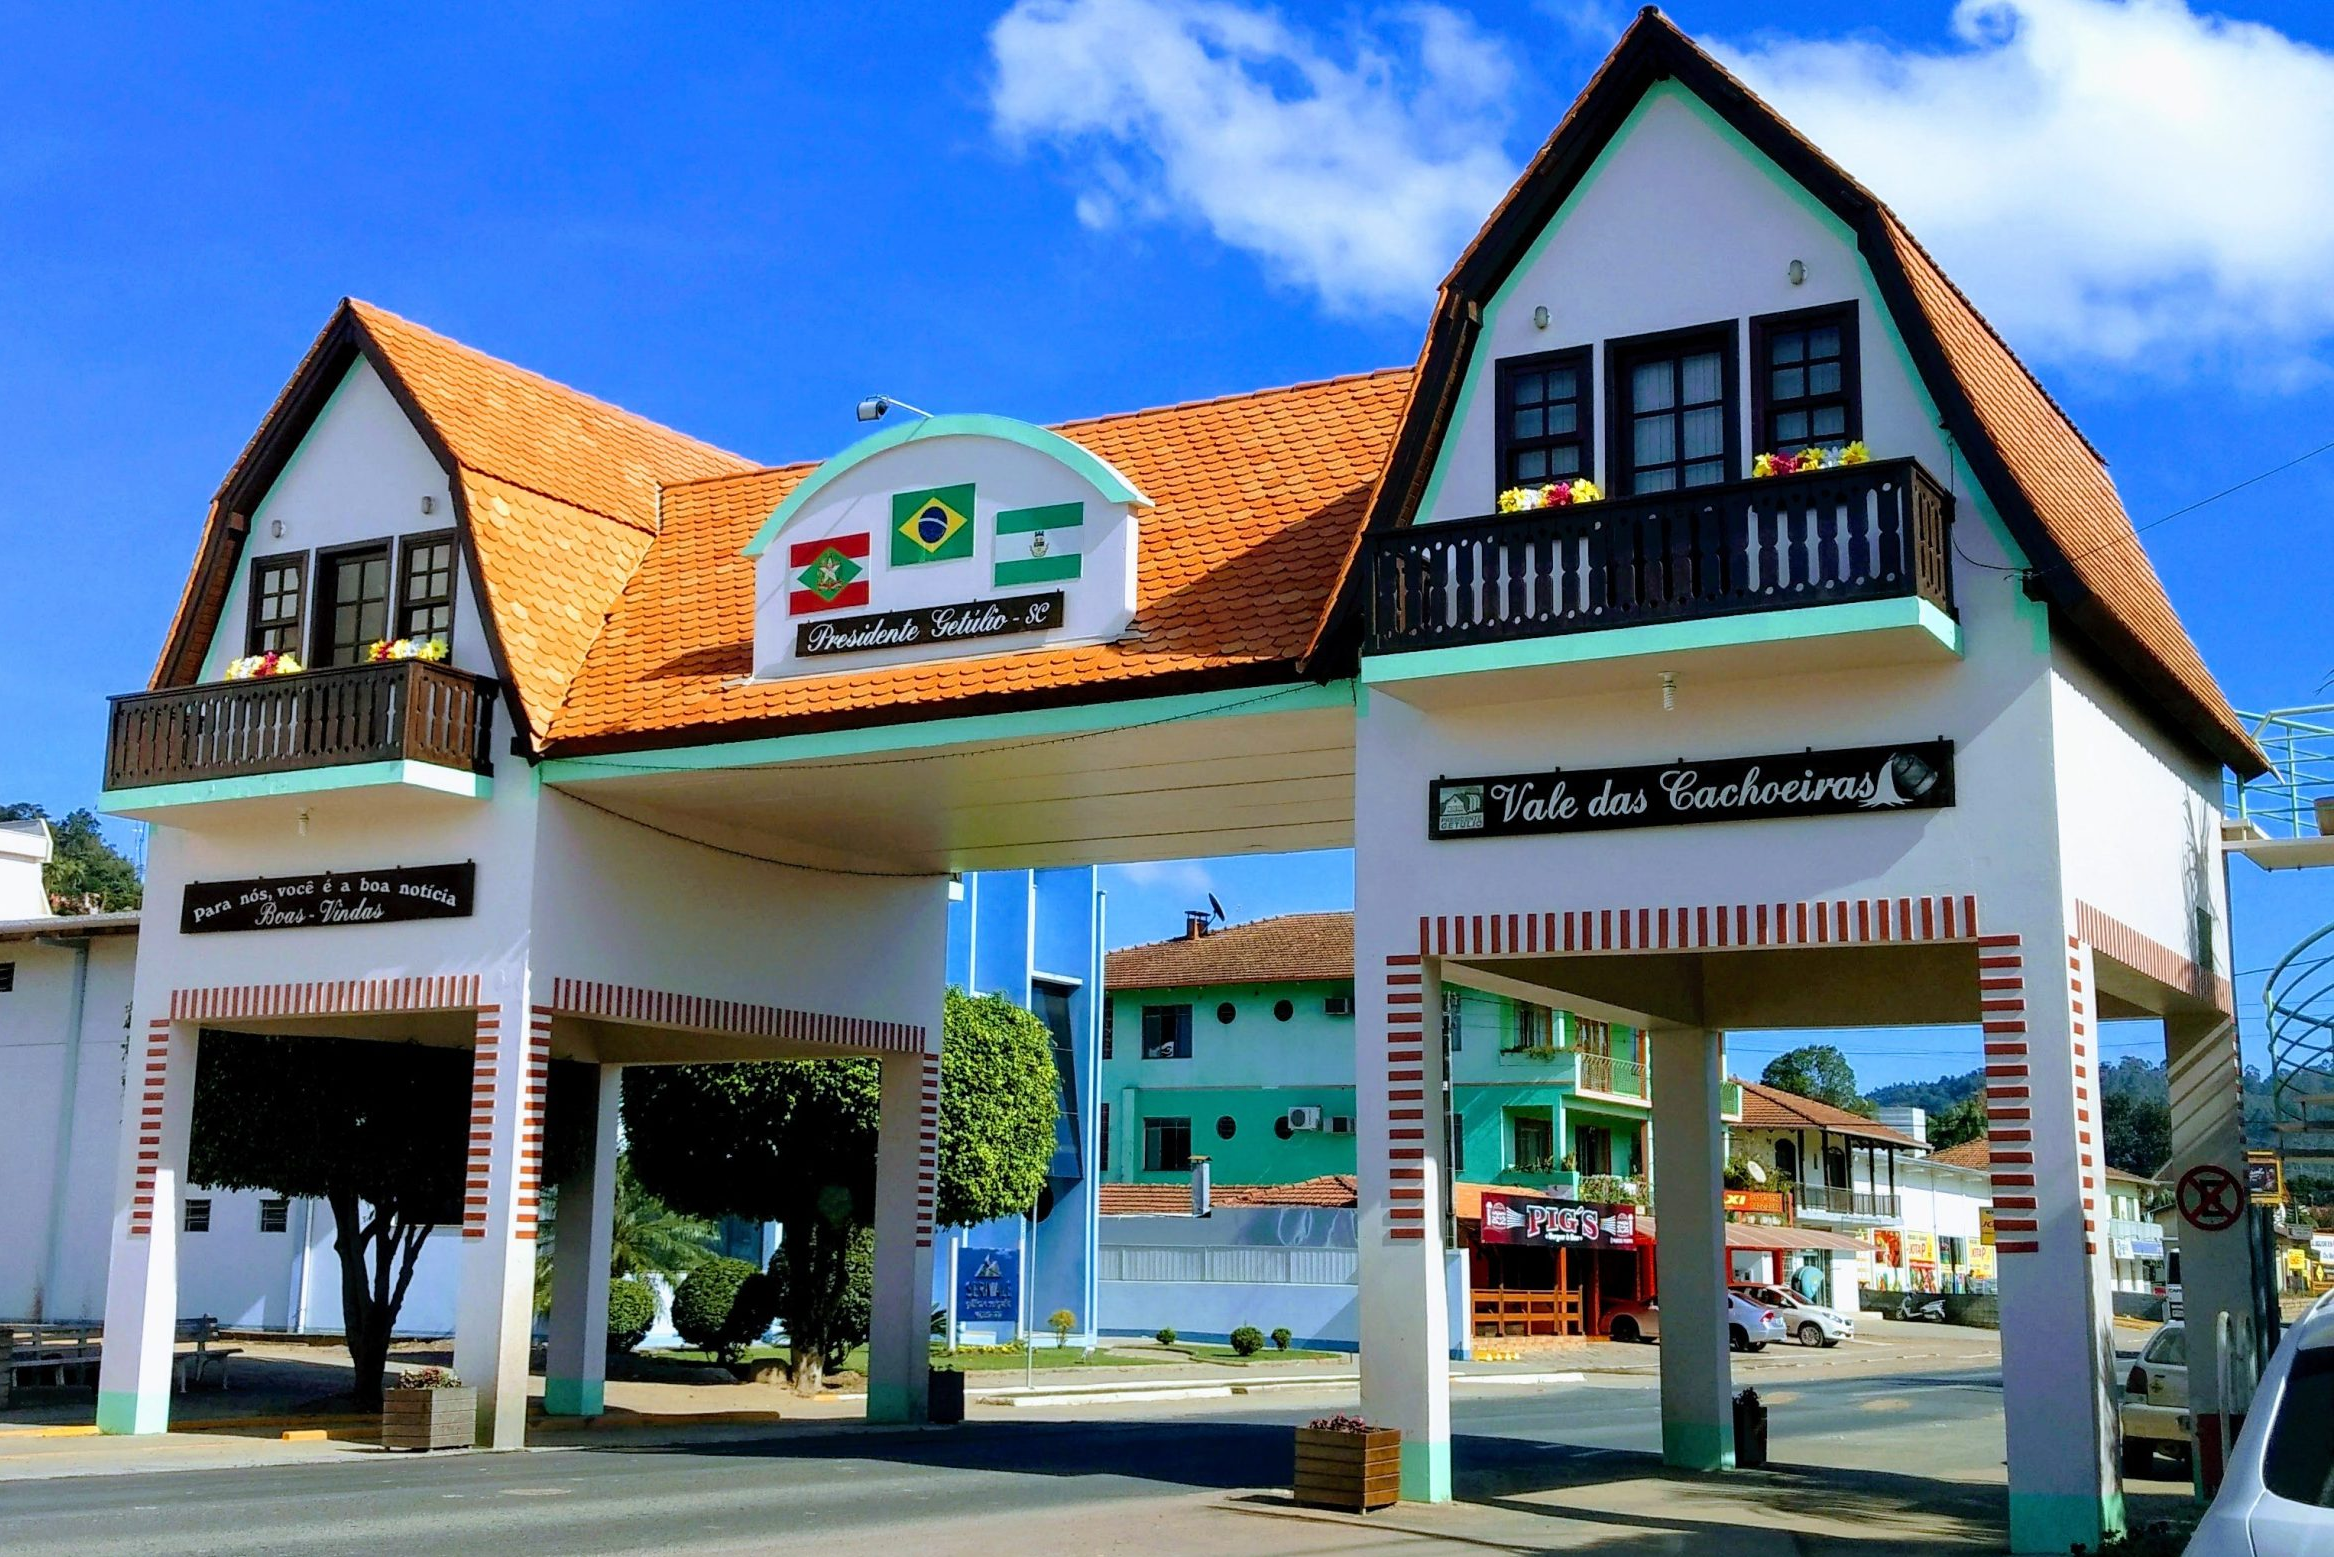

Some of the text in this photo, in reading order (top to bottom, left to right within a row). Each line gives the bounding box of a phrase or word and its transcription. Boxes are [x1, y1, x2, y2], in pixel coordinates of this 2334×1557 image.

[806, 618, 920, 652] Presidente
[930, 607, 1008, 638] Getúlio
[1025, 602, 1050, 625] SC
[1490, 765, 1876, 823] Vale das Cachoeiras
[194, 876, 457, 923] Para nós, você é a boa notícia
[254, 900, 305, 926] Boas
[319, 897, 385, 923] Vindas
